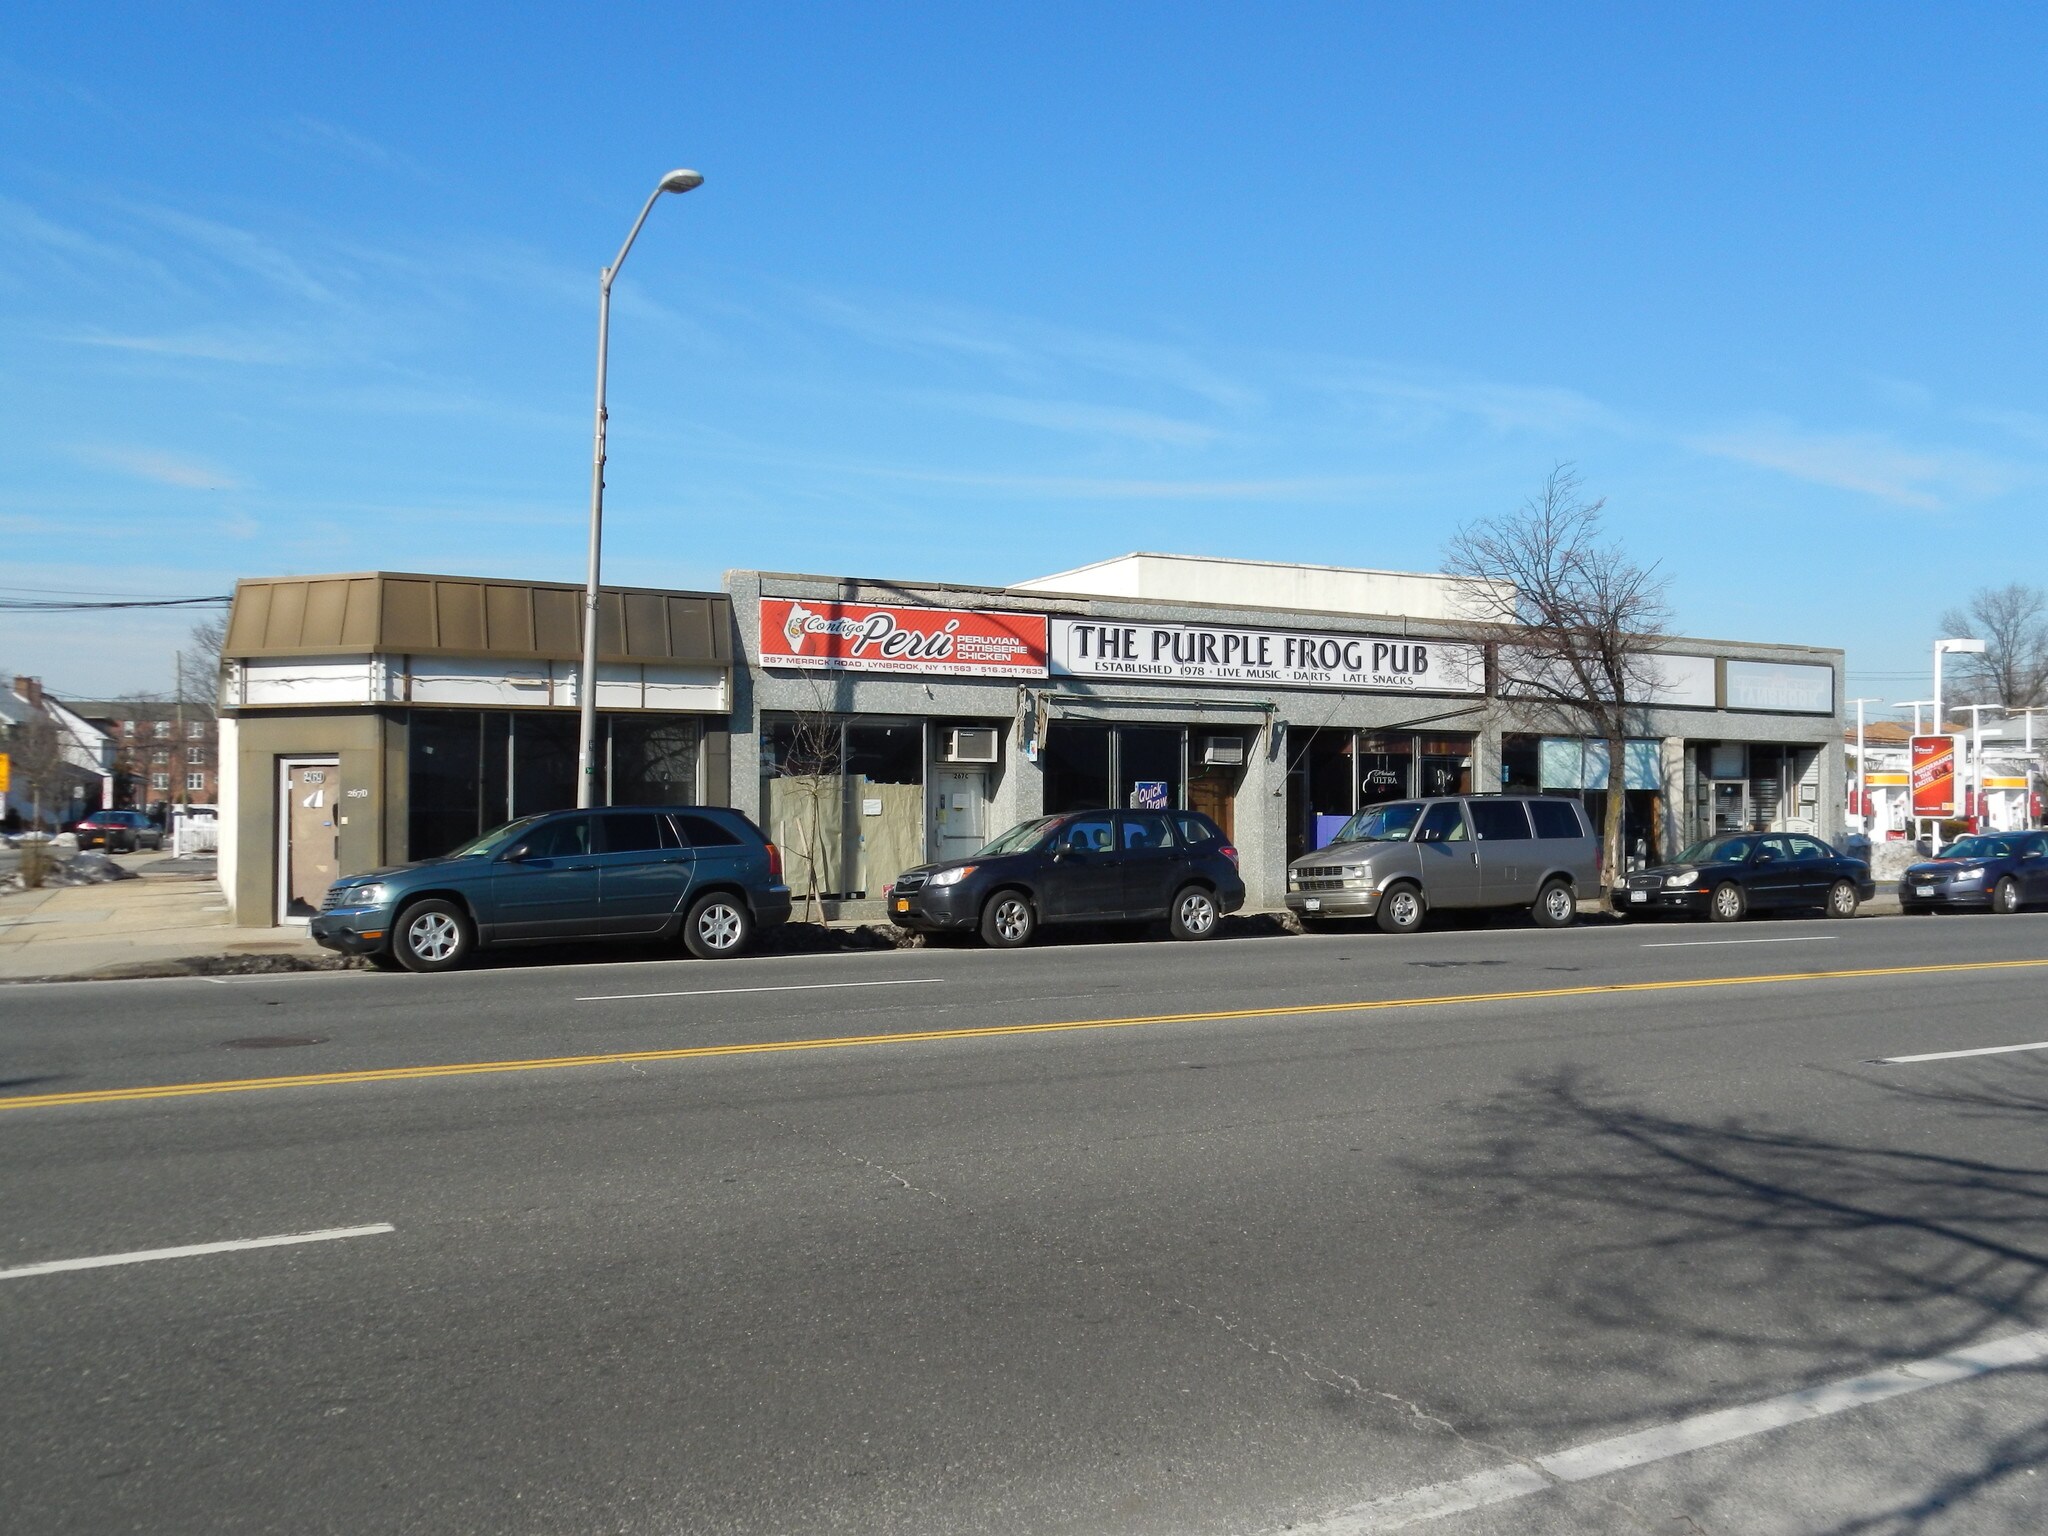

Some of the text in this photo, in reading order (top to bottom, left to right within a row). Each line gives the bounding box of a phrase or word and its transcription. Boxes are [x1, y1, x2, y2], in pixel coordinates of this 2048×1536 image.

[806, 616, 865, 637] Contigo
[853, 615, 958, 655] Perú
[957, 635, 1020, 646] PERUVIAN
[957, 643, 1028, 654] ROTISSERIE
[1073, 625, 1429, 675] THE PURPLE FROG PUB
[956, 652, 1012, 662] CHICKEN
[763, 656, 783, 664] 267
[786, 657, 830, 666] MERRICK
[981, 666, 1044, 675] 516.341.7633
[1094, 662, 1415, 685] ESTABLISHED 1978 LIVE MUSIC DARTS LATE SNACKS
[304, 771, 325, 783] 269
[953, 772, 969, 780] 267C
[1373, 776, 1398, 784] ULTRA
[347, 788, 368, 799] 267D
[1138, 782, 1162, 803] Quick
